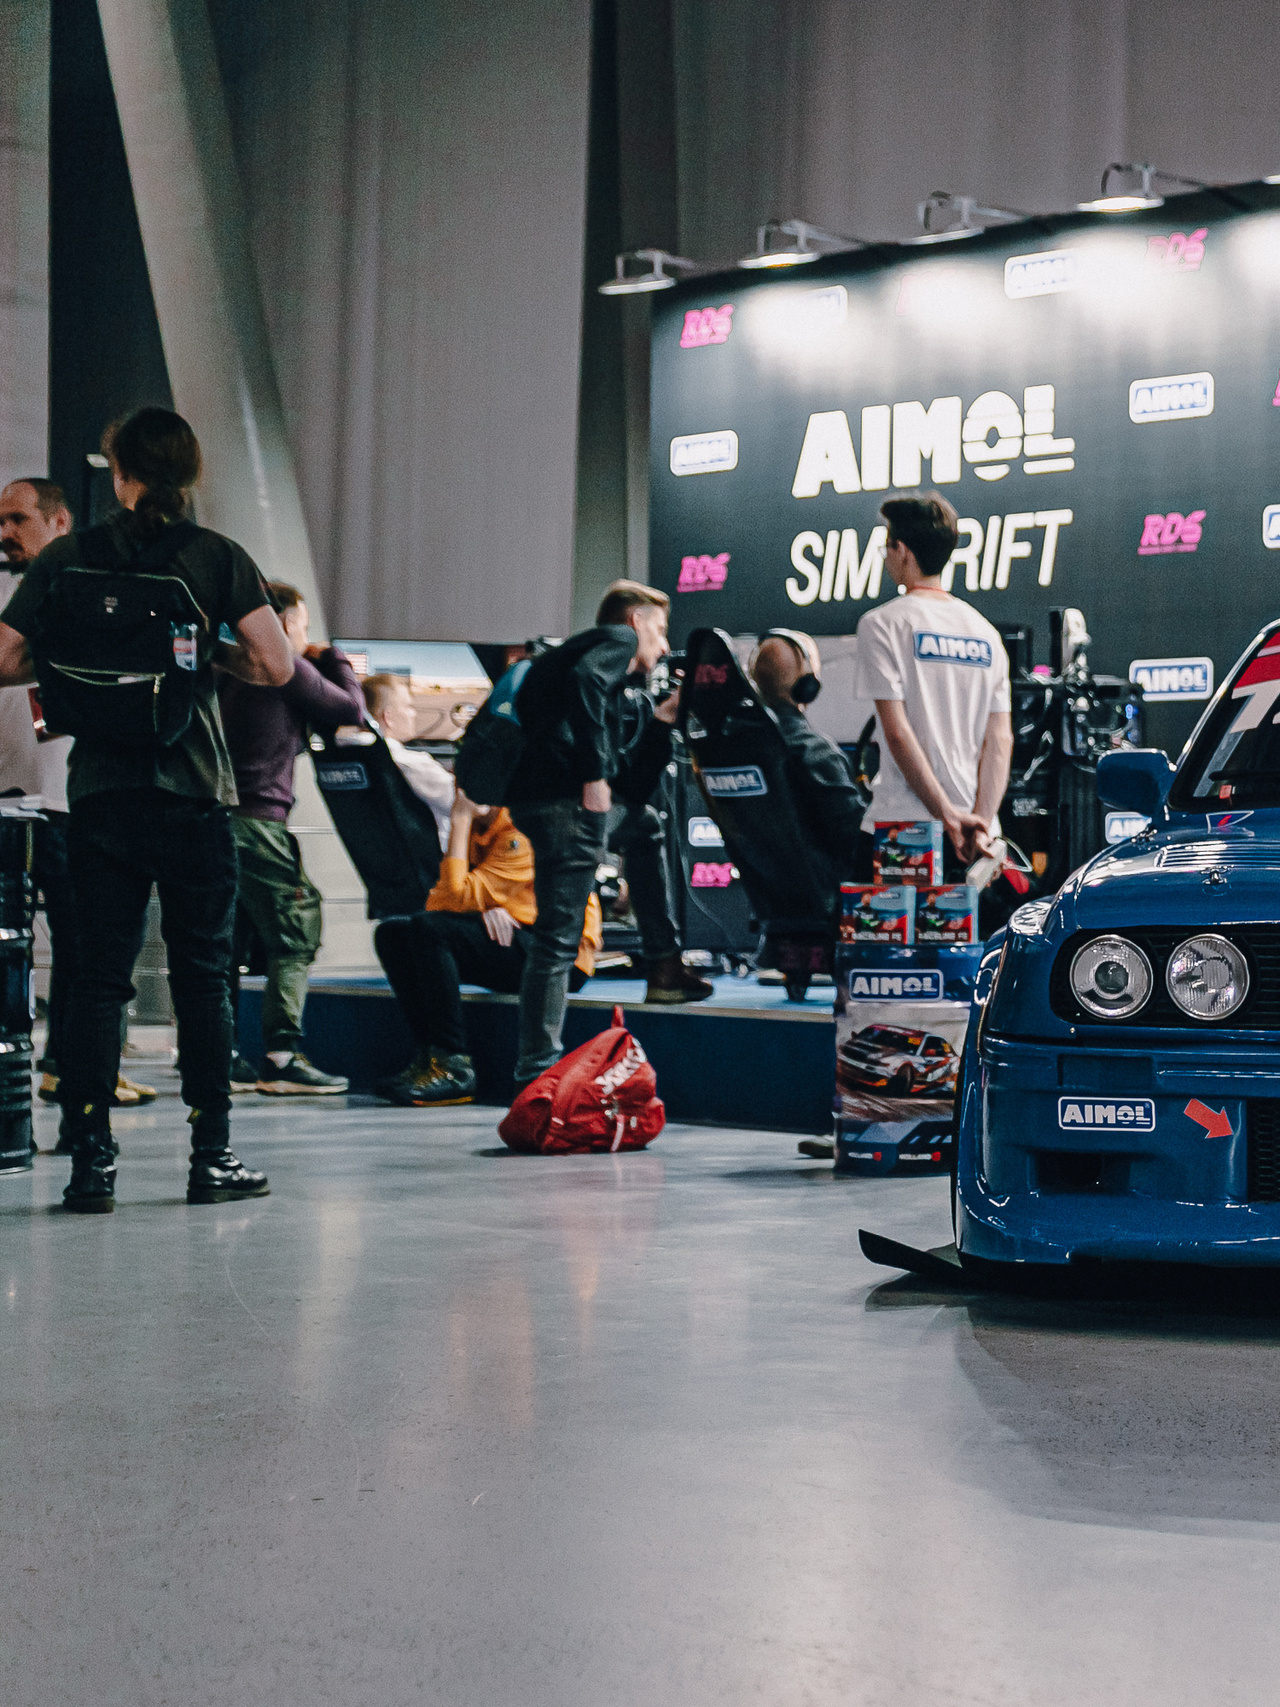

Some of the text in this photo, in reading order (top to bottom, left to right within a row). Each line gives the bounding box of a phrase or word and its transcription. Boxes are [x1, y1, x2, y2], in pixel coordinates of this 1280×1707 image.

[1133, 380, 1207, 415] AIMOL
[792, 384, 1075, 498] AIMOL
[1139, 510, 1206, 547] RDS
[786, 509, 1073, 606] SIM RIFT
[918, 633, 992, 664] AIMOL
[851, 974, 938, 998] AIMOL
[1063, 1103, 1151, 1126] AIMOL
